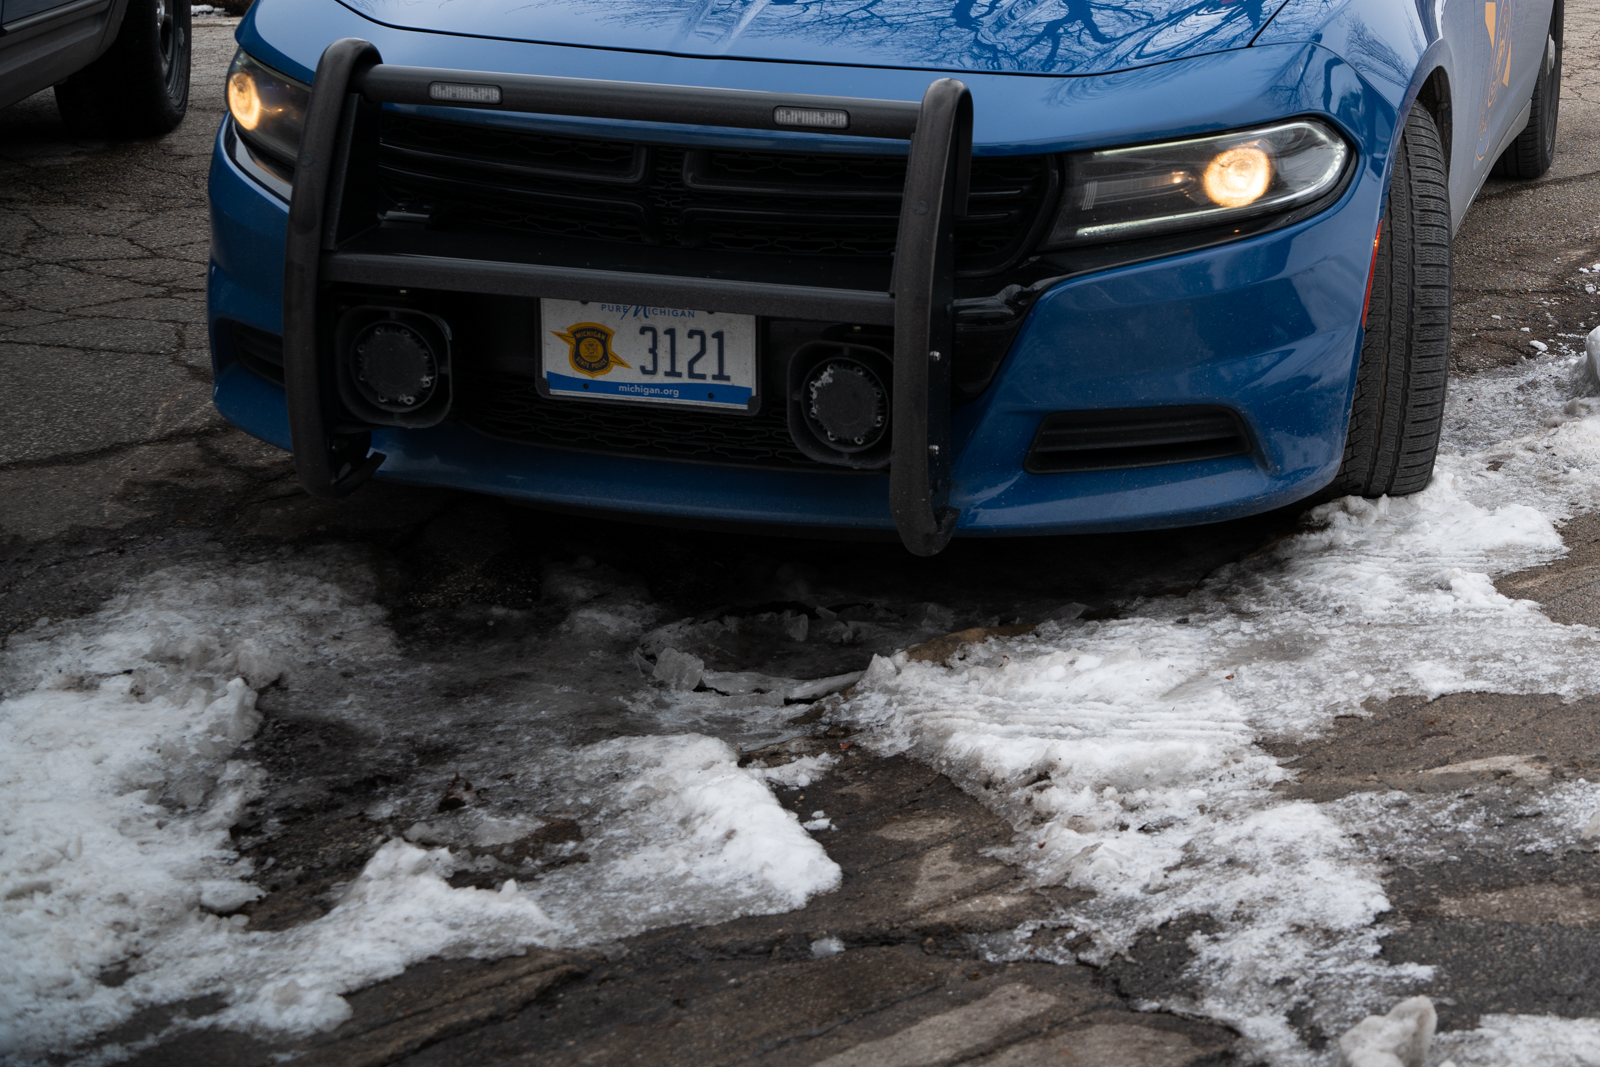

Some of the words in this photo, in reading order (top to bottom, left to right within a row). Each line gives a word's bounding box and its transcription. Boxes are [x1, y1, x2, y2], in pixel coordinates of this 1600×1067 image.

[601, 303, 629, 313] PURE
[621, 304, 695, 320] MICHIGAN
[575, 330, 606, 340] MICHIGAN
[639, 326, 731, 381] 3121
[575, 356, 590, 368] STATE
[591, 358, 608, 369] POLICE
[619, 385, 680, 398] michigan.org
